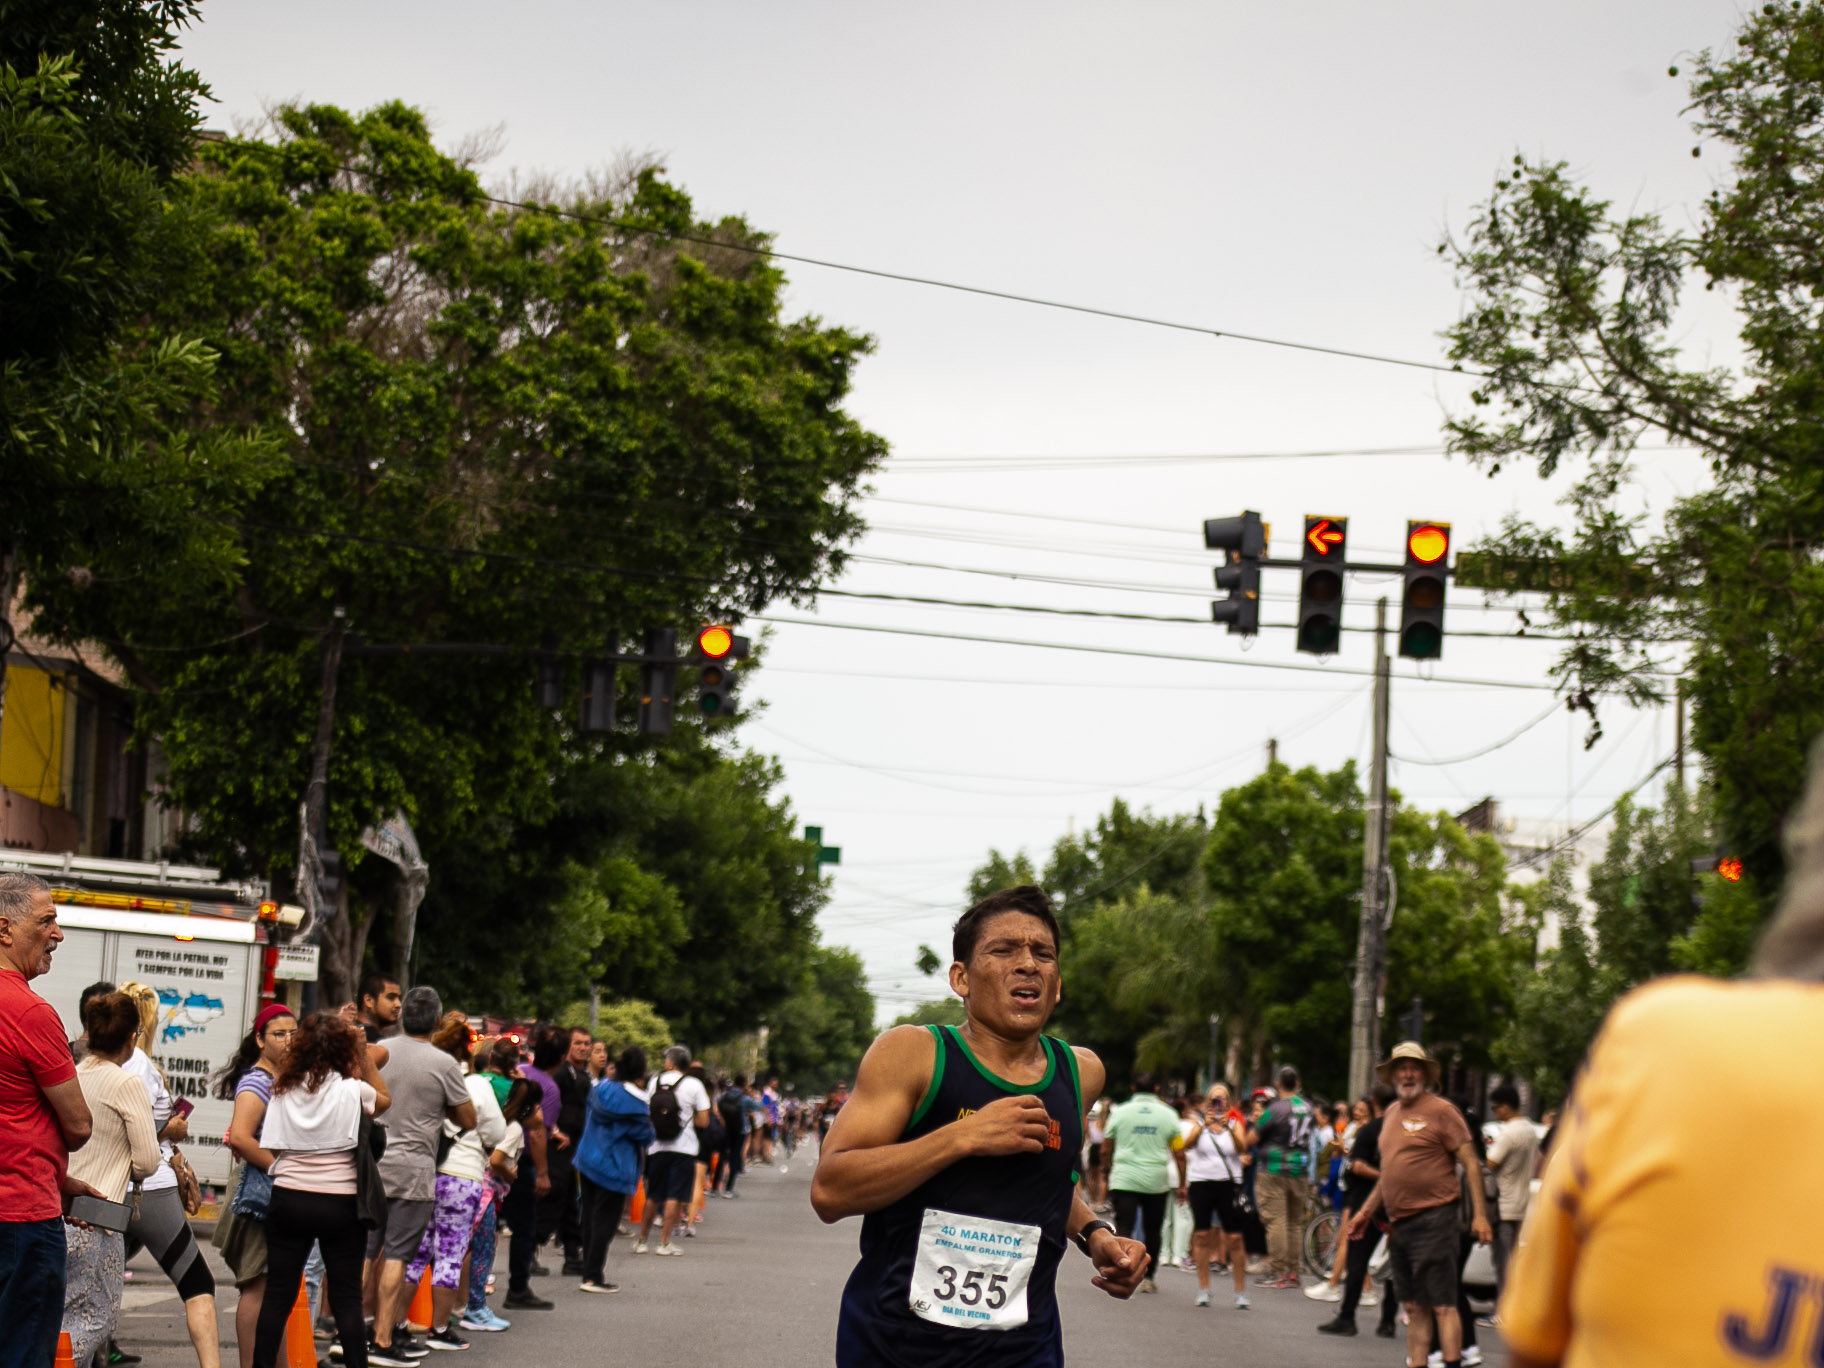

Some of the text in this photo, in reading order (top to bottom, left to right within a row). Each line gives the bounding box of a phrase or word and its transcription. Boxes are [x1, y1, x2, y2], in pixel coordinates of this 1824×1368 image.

[173, 952, 182, 962] LA
[144, 964, 177, 976] SIEMPRE
[195, 968, 205, 978] LA
[167, 1056, 210, 1074] SOMOS
[167, 1076, 208, 1098] INAS
[941, 1225, 1022, 1247] 40 MARATON
[935, 1238, 1023, 1259] EMPALME GRANEROS
[933, 1265, 1009, 1310] 355
[954, 1307, 965, 1316] DEL
[967, 1309, 991, 1320] VECINO
